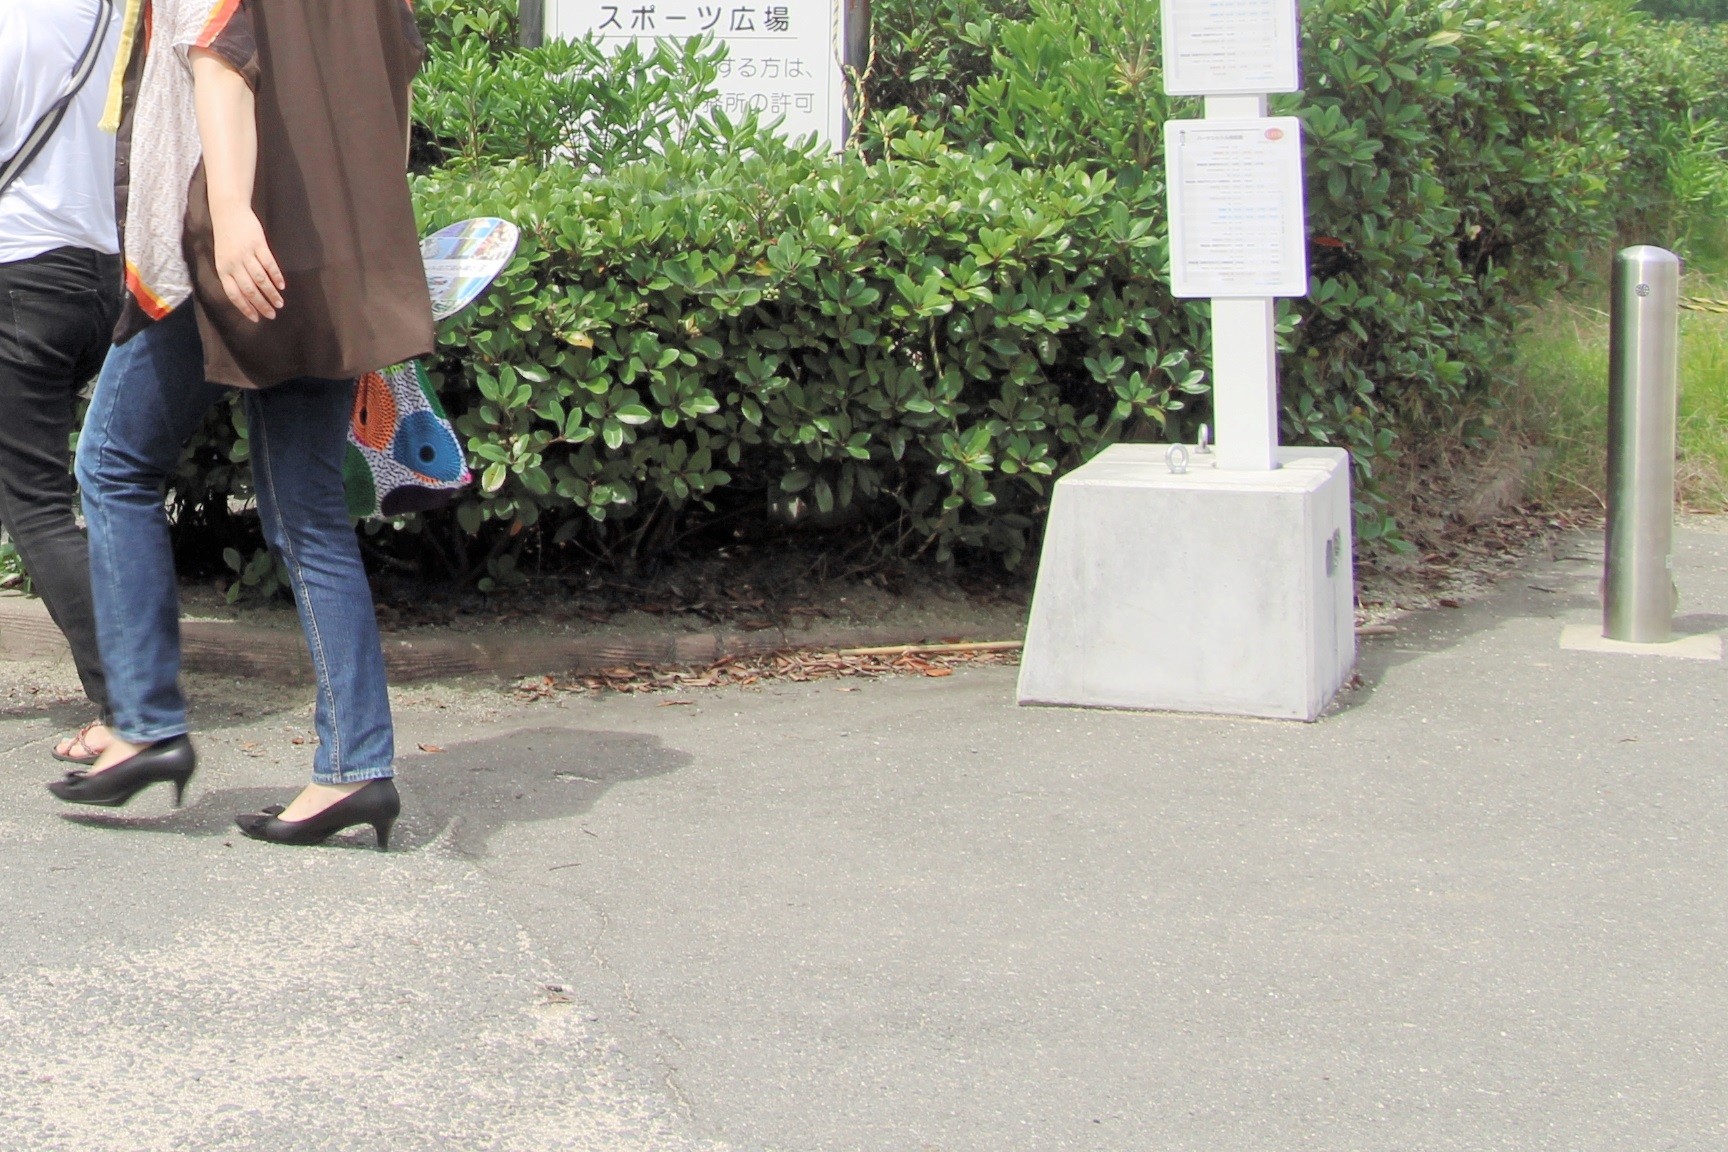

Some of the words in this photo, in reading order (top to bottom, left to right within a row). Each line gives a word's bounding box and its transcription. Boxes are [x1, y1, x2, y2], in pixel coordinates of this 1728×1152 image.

[598, 4, 791, 33] スポーツ広場
